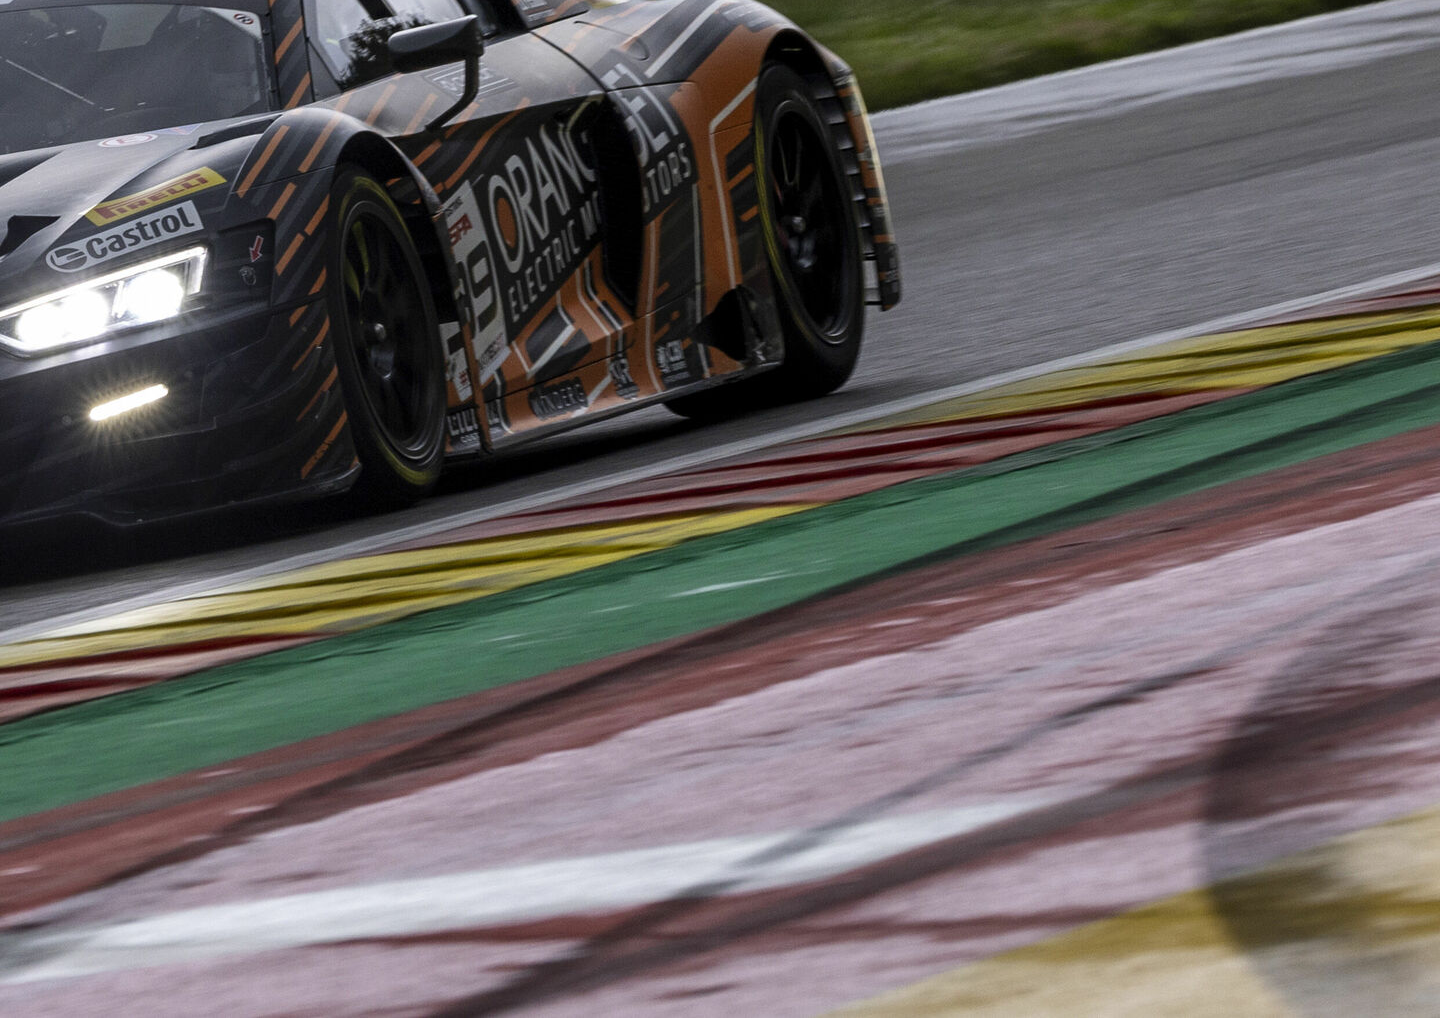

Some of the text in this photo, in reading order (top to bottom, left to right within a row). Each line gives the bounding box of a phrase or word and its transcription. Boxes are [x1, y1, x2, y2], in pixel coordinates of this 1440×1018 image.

[93, 173, 209, 220] PIRELLI
[85, 206, 196, 259] Castrol
[509, 219, 580, 323] ELECTRIC
